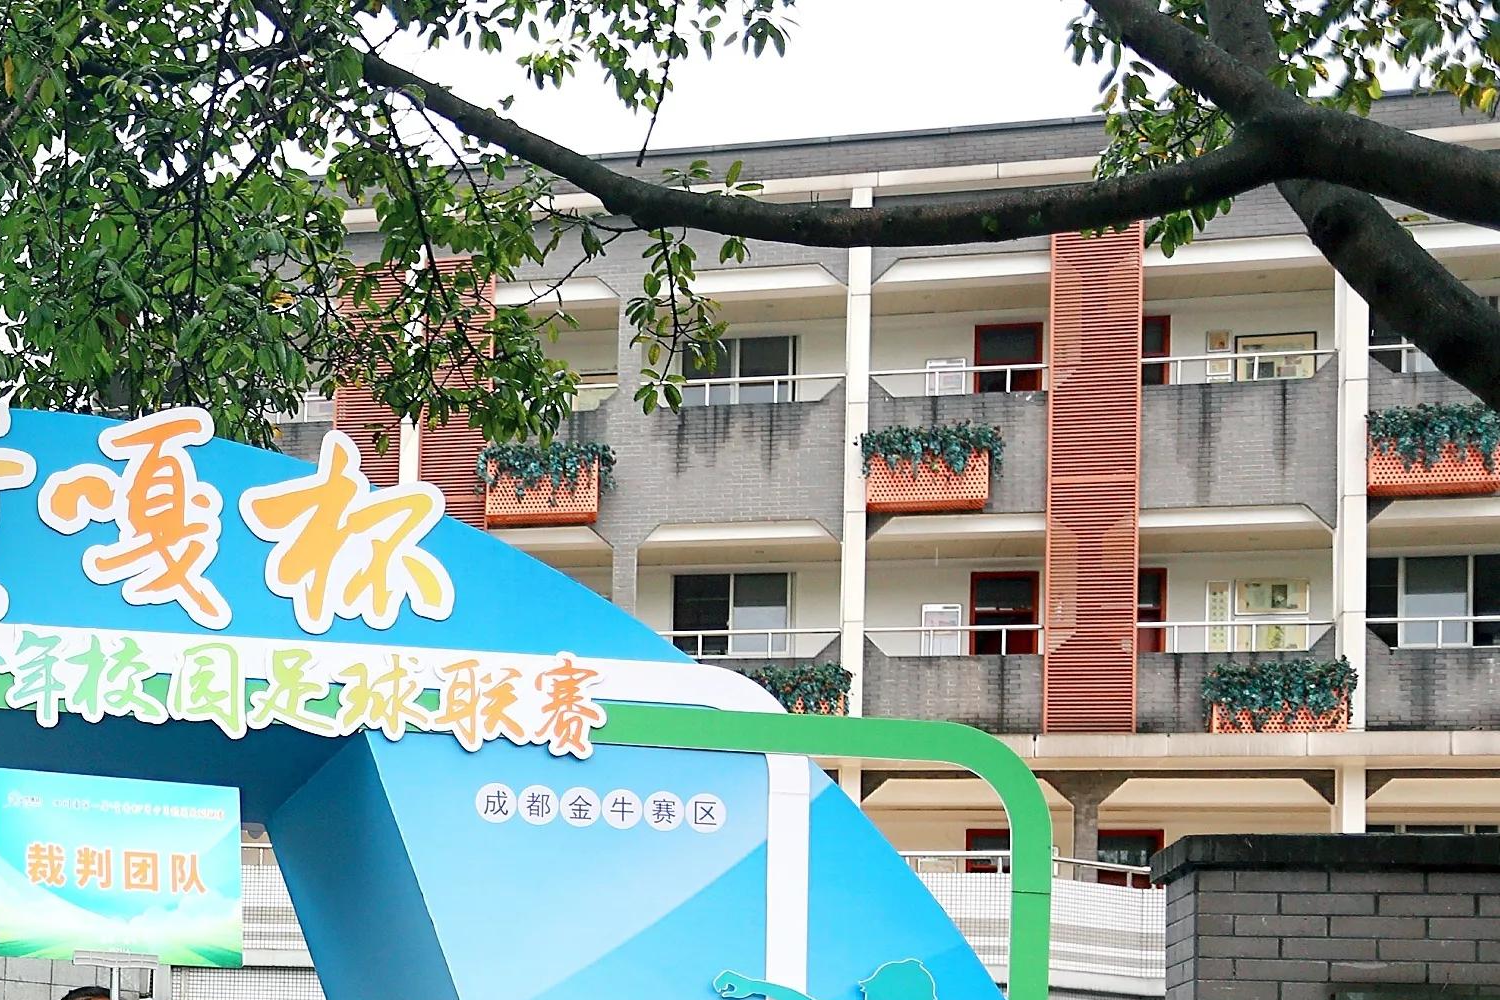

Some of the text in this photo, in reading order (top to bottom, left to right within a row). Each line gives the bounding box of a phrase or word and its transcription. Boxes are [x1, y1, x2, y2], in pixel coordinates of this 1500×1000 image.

[483, 790, 718, 826] 成都金牛赛区
[27, 843, 207, 894] 裁判团队
